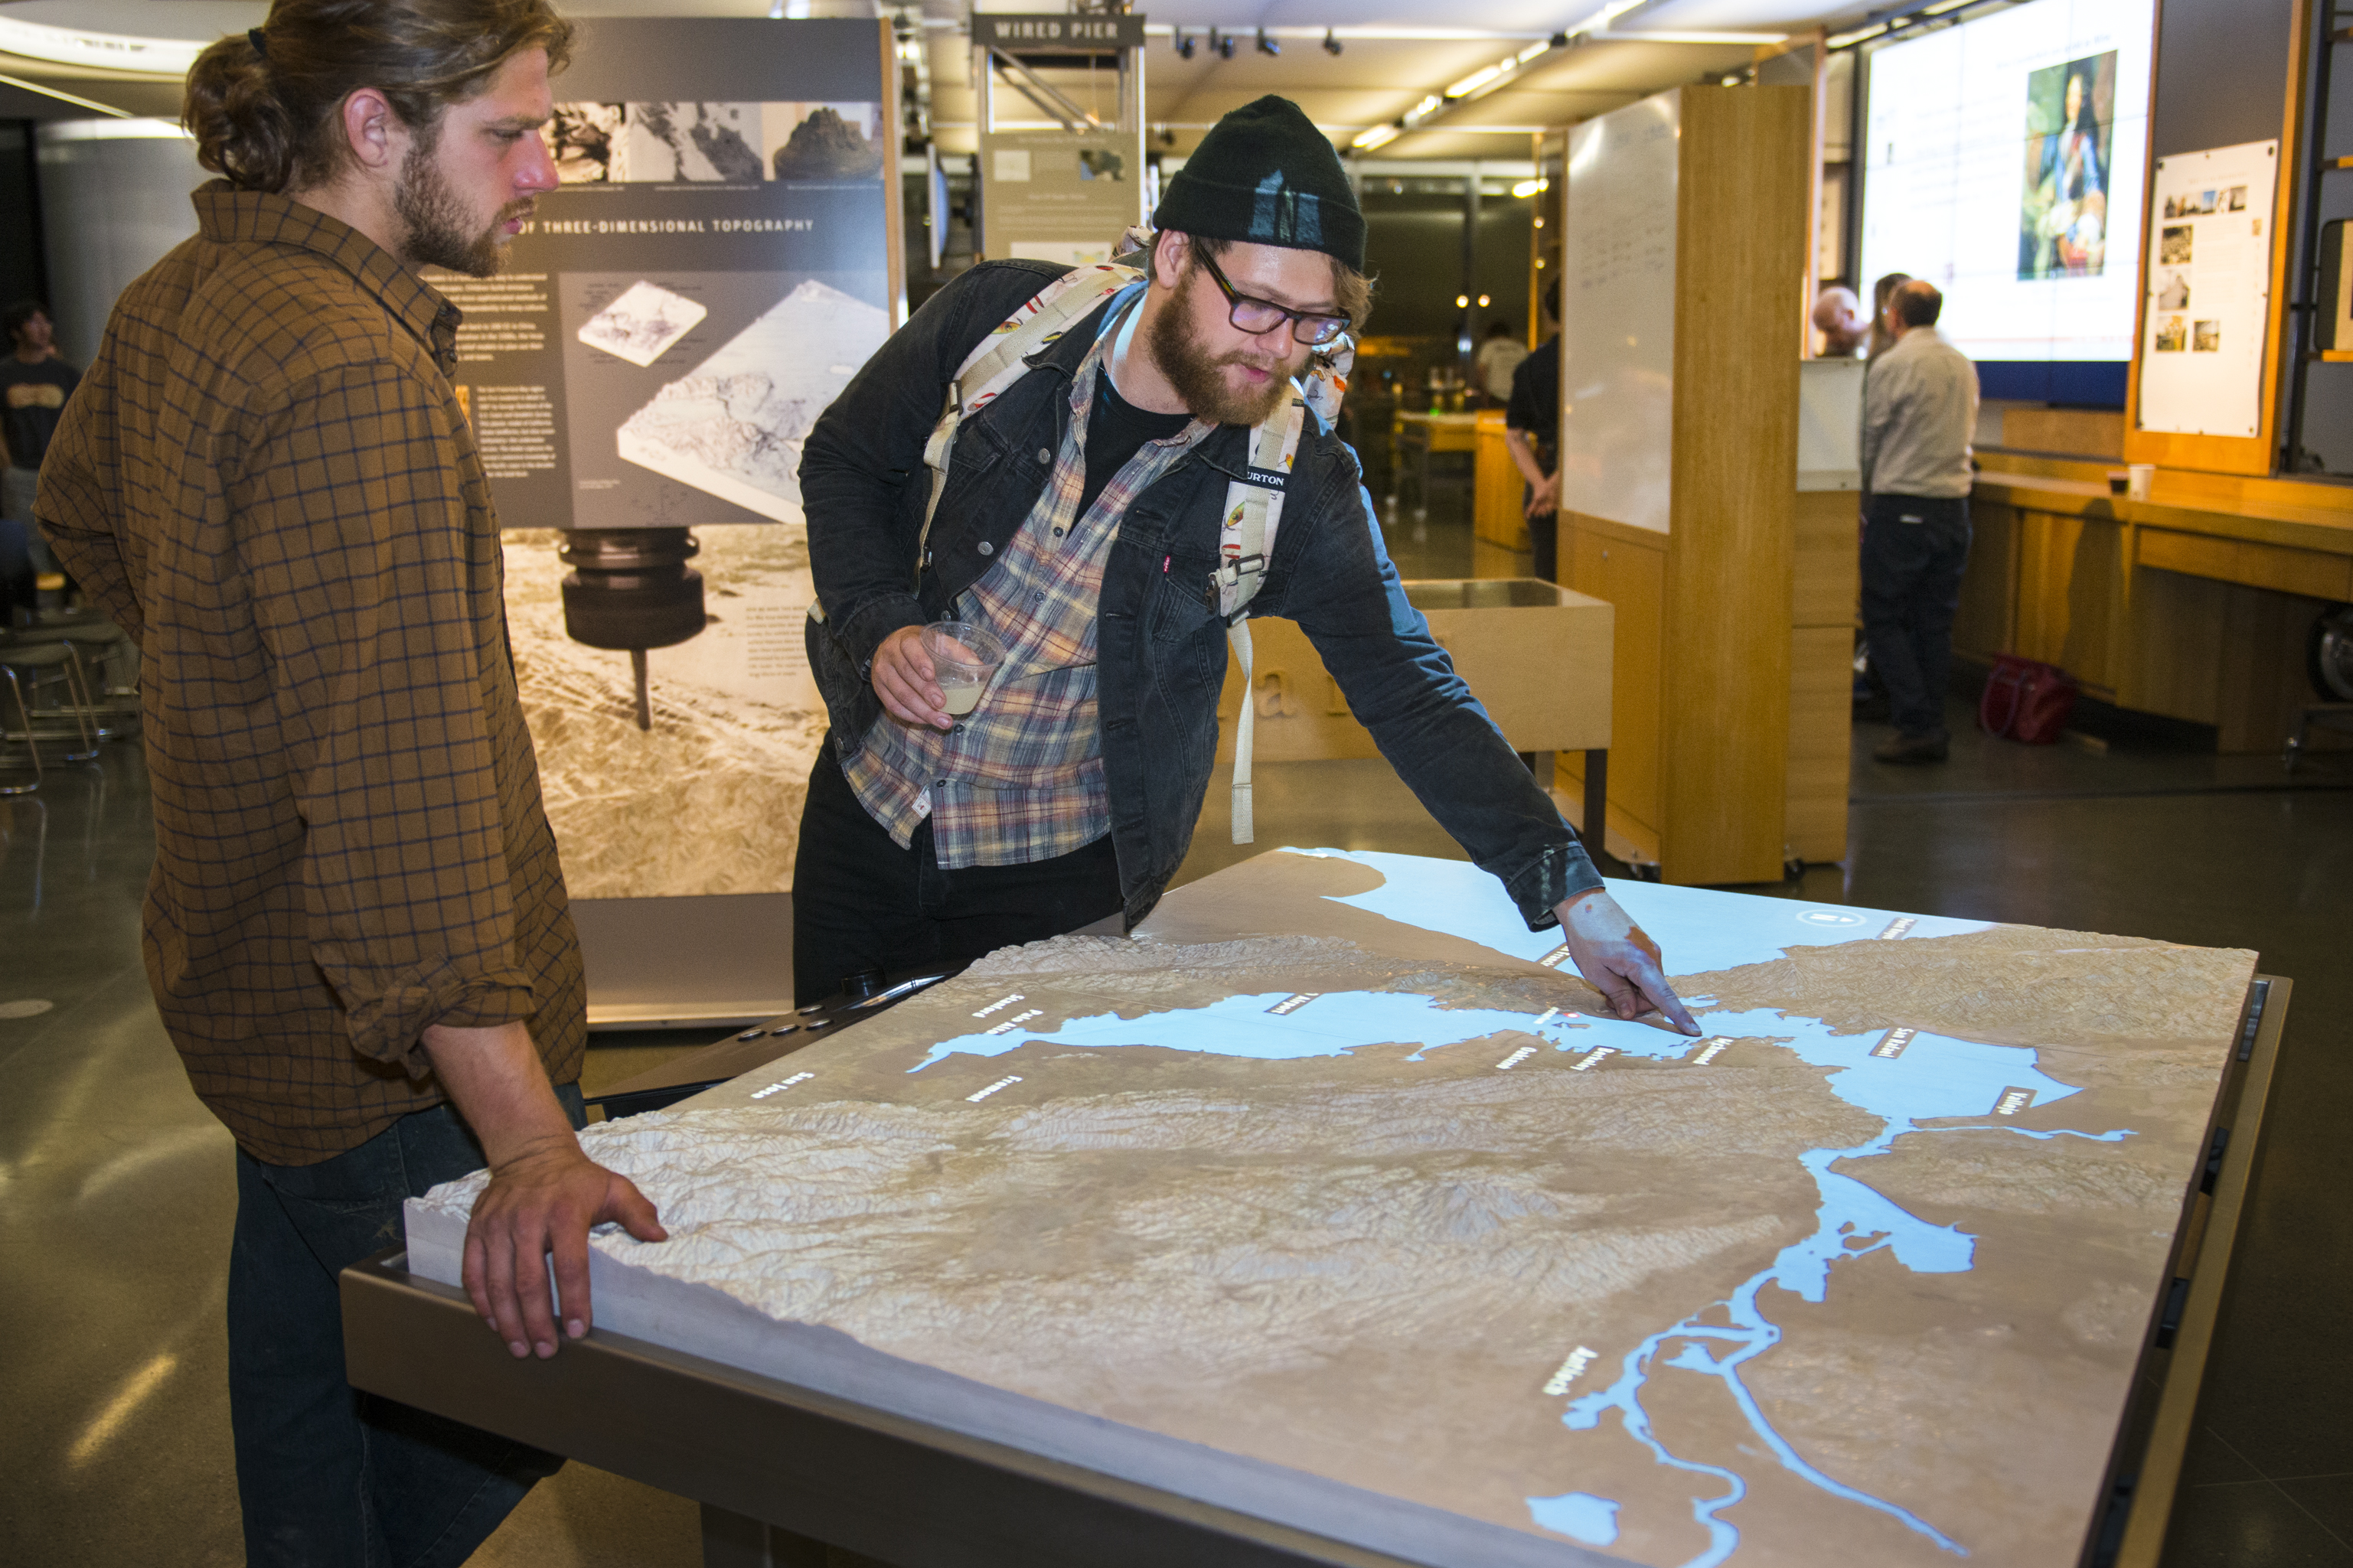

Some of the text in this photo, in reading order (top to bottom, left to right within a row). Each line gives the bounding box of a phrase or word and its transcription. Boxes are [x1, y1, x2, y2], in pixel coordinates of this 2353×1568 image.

[995, 22, 1118, 38] WIRED PIER
[543, 219, 705, 234] THREE-DIMENSIONAL
[712, 218, 814, 233] TOPOGRAPHY
[1248, 471, 1284, 486] URTON
[971, 993, 1025, 1018] Stanford
[1270, 995, 1310, 1014] Airport
[985, 1009, 1044, 1035] Palo Alto
[1877, 1027, 1914, 1058] San Rafael
[1495, 1046, 1537, 1070] Oakland
[1569, 1047, 1616, 1071] Berkeley
[750, 1071, 815, 1099] San Jose
[965, 1075, 1023, 1103] Fremont
[1996, 1092, 2028, 1116] Vallejo
